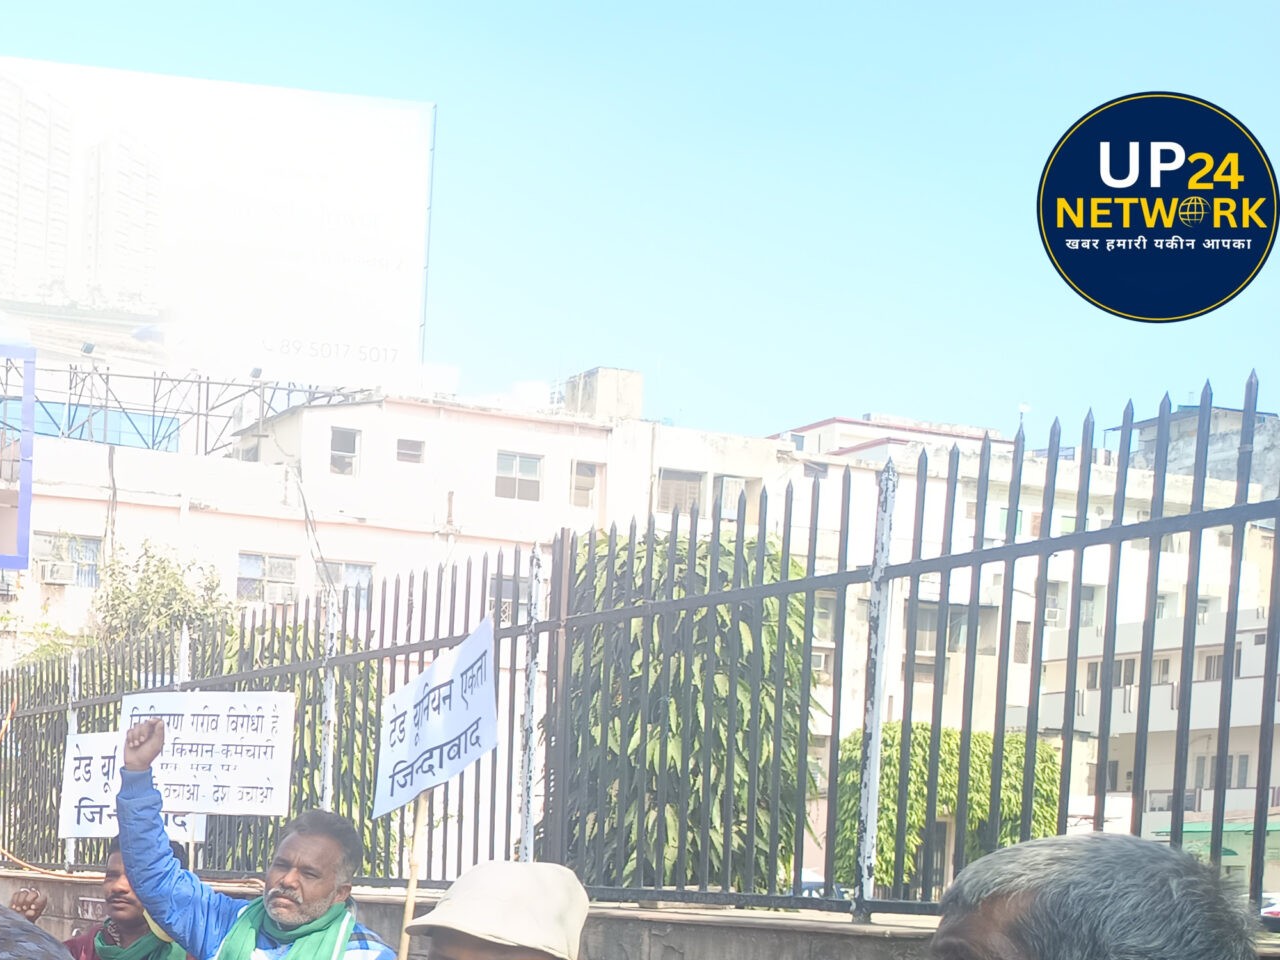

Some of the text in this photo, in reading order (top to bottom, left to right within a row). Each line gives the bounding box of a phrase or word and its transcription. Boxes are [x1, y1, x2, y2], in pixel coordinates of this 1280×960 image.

[308, 340, 351, 359] 5017
[358, 345, 399, 363] 5017
[460, 650, 487, 710] एकता
